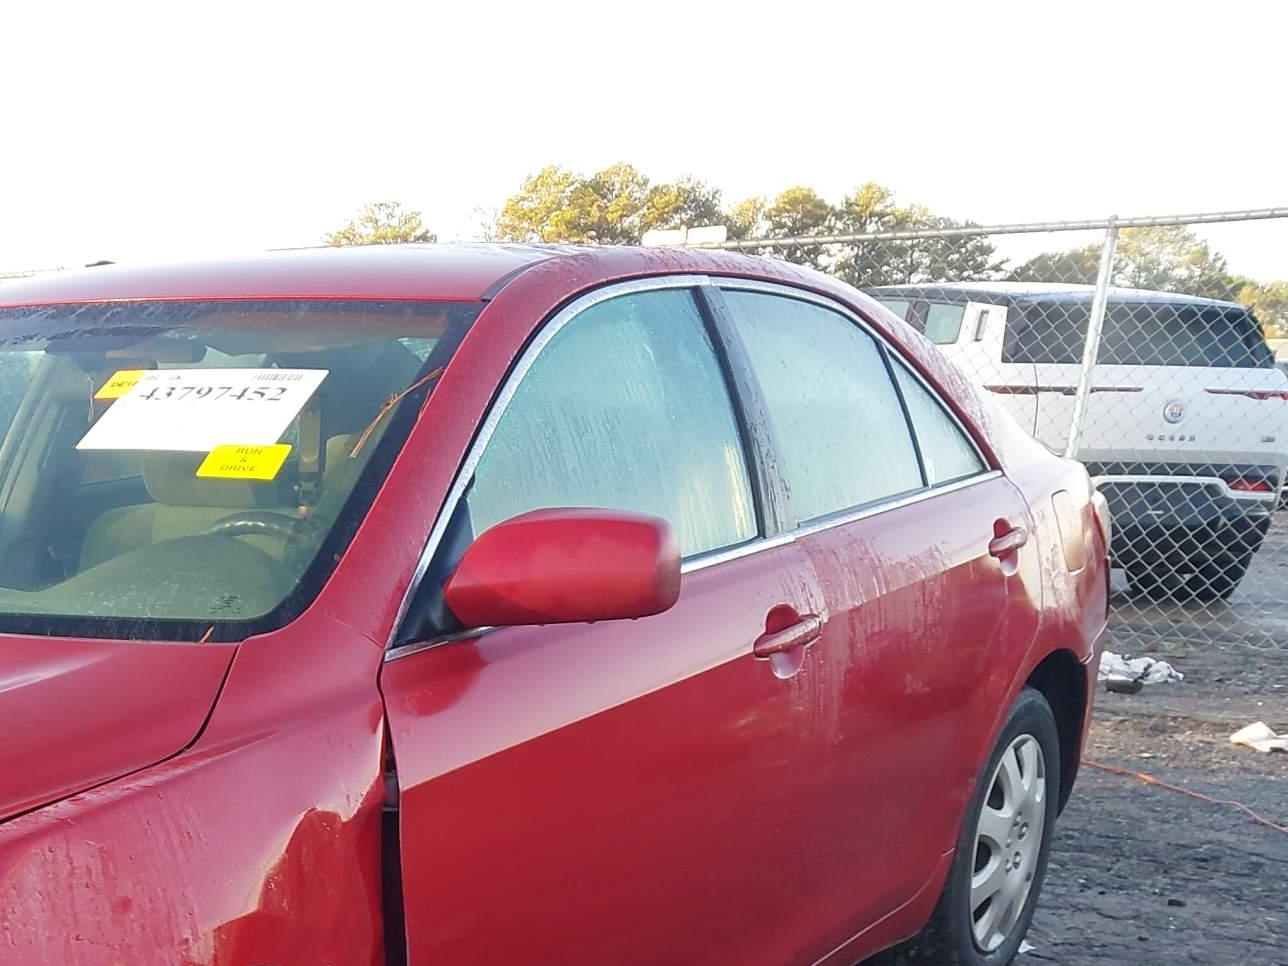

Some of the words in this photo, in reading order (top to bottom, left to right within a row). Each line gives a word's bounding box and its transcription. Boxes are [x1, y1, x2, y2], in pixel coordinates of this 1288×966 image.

[139, 386, 287, 401] 43797452
[236, 447, 263, 455] RUN
[220, 464, 257, 472] DRIVE
